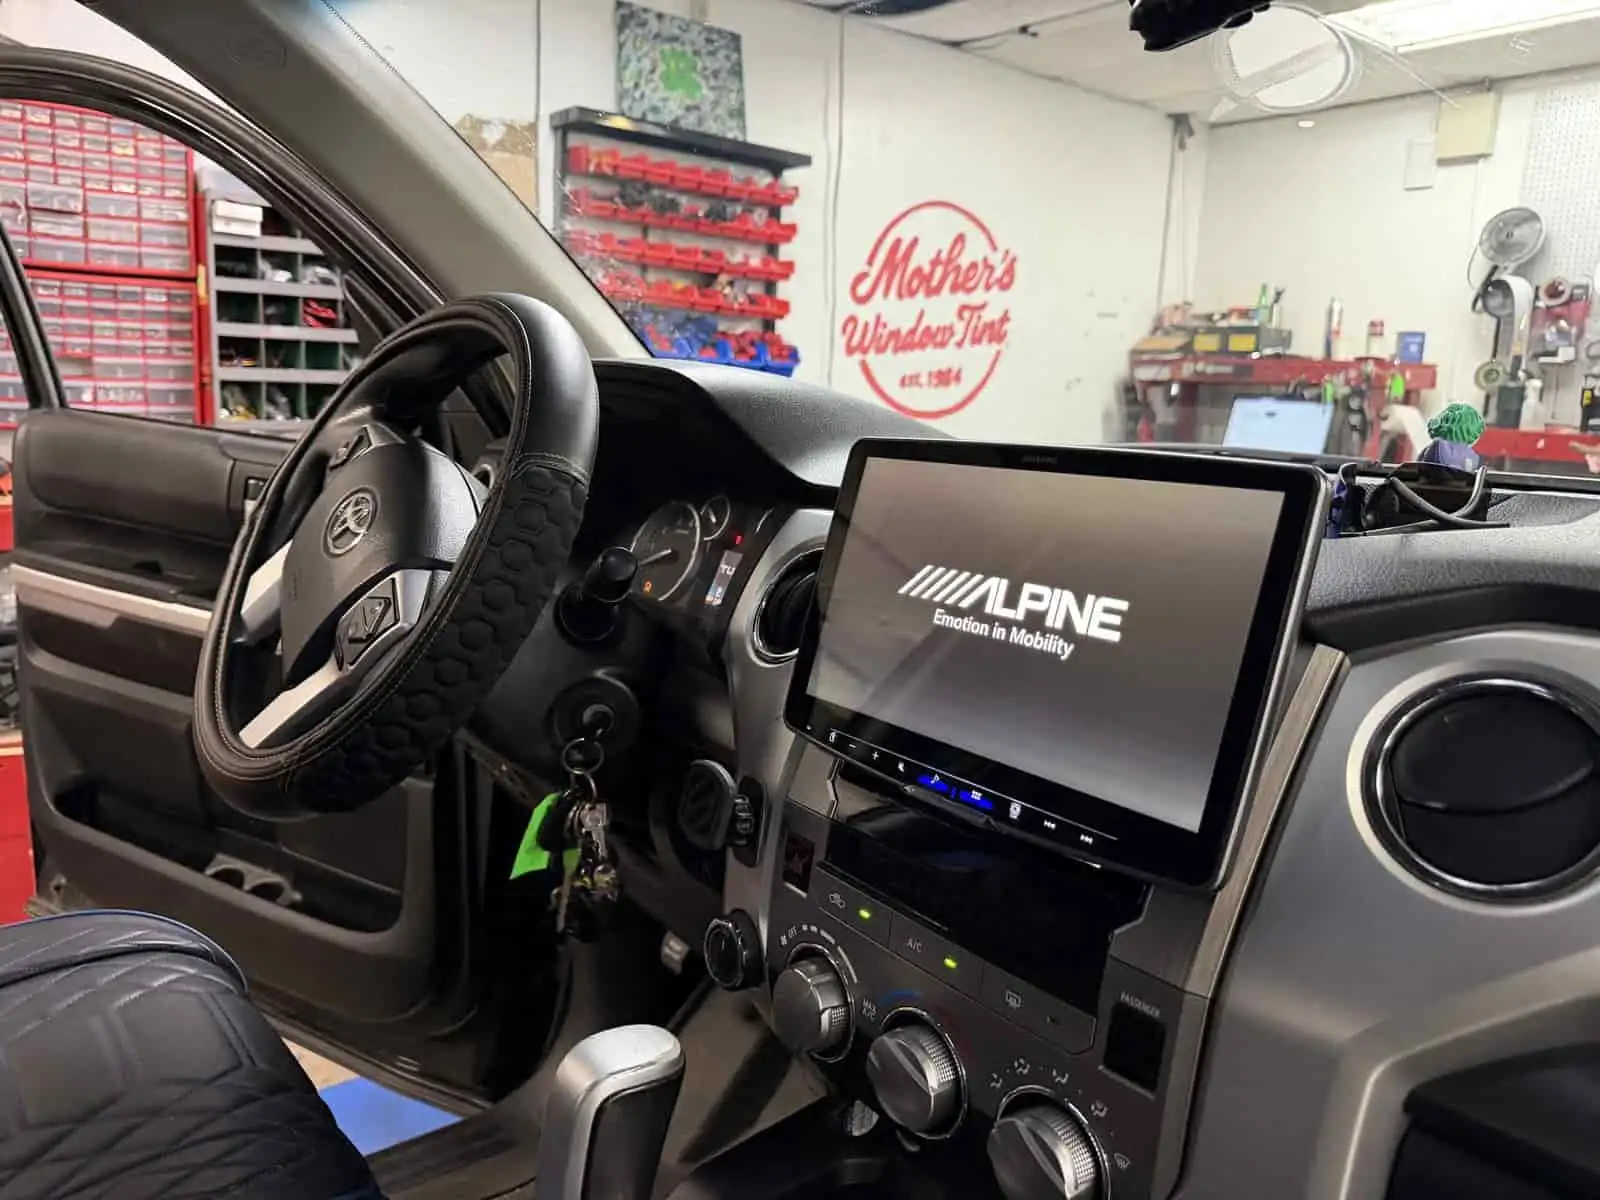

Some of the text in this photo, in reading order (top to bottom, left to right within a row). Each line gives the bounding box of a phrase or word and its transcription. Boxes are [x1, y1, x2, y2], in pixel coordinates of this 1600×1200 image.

[850, 232, 1017, 304] Mother's
[842, 301, 1011, 357] Window Tint
[932, 608, 1075, 661] Emotion in Mobility
[957, 576, 1130, 642] ALPINE
[907, 938, 923, 952] A/C
